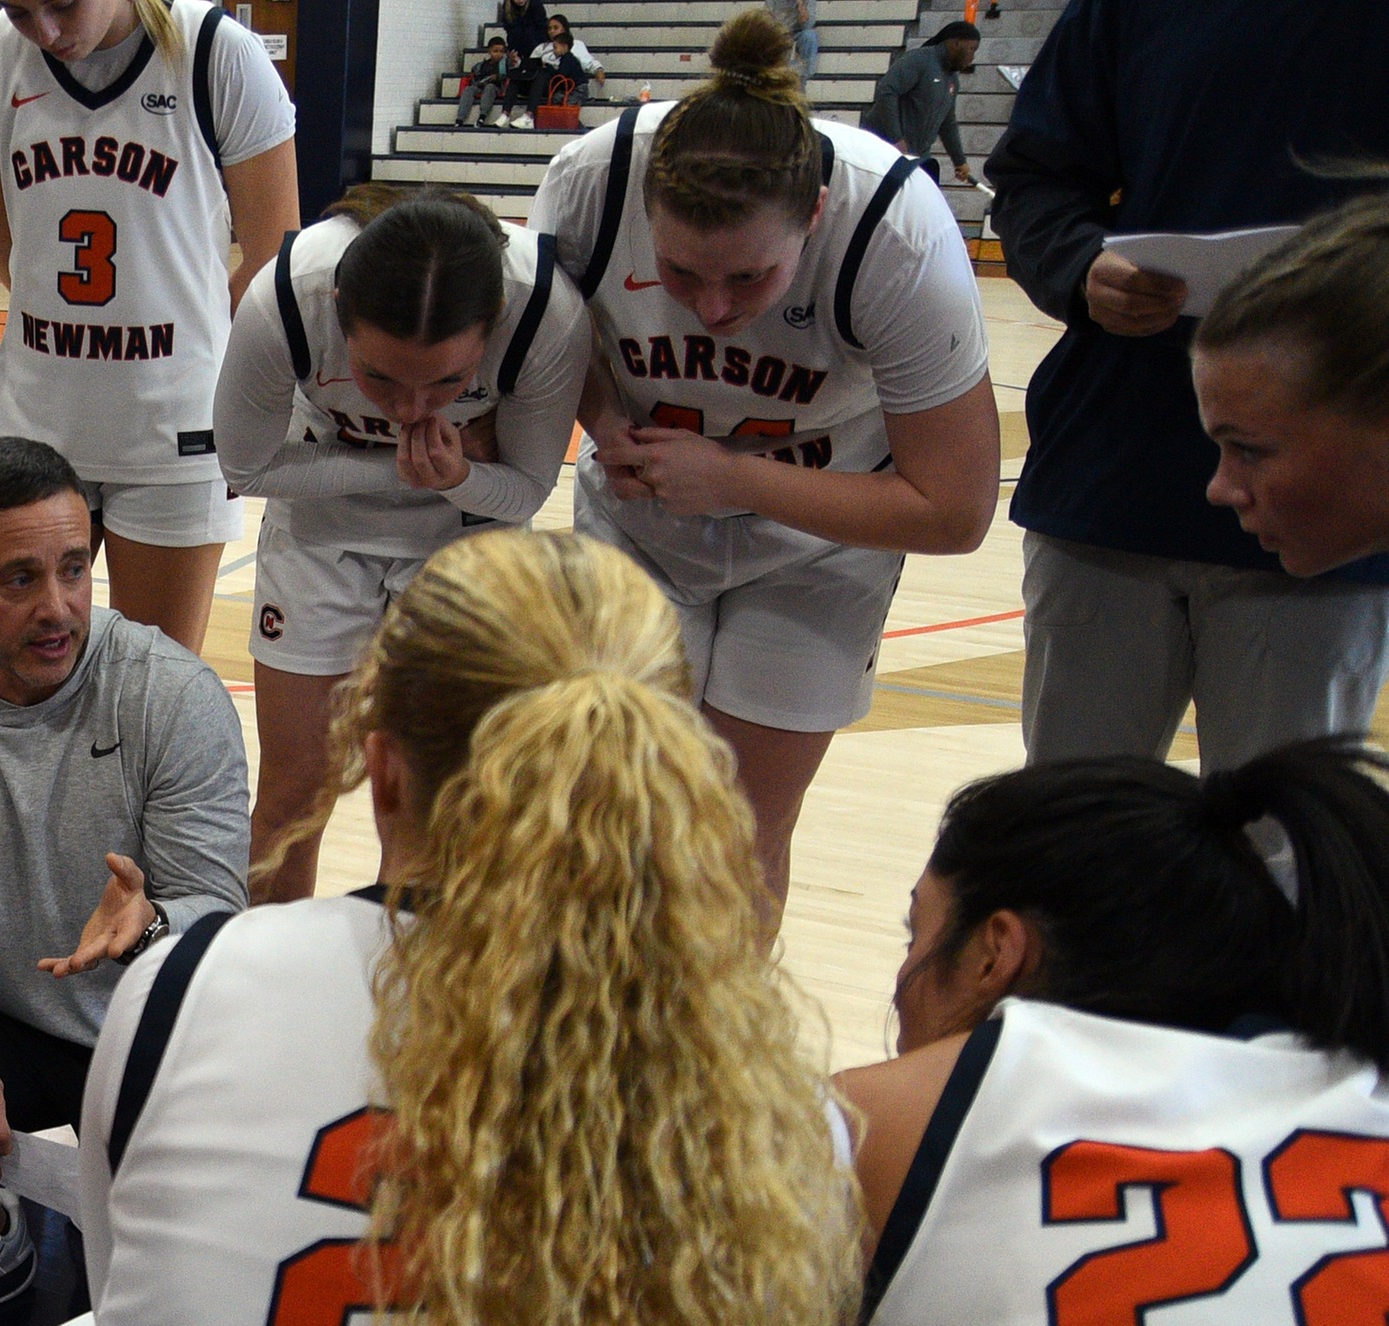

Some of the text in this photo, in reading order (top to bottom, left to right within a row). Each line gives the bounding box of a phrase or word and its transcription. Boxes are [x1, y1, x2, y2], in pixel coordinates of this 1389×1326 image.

[146, 93, 177, 110] SAC
[11, 136, 179, 198] CARSON
[57, 208, 117, 307] 3
[21, 310, 175, 361] NEWMAN
[618, 335, 828, 405] CARSON
